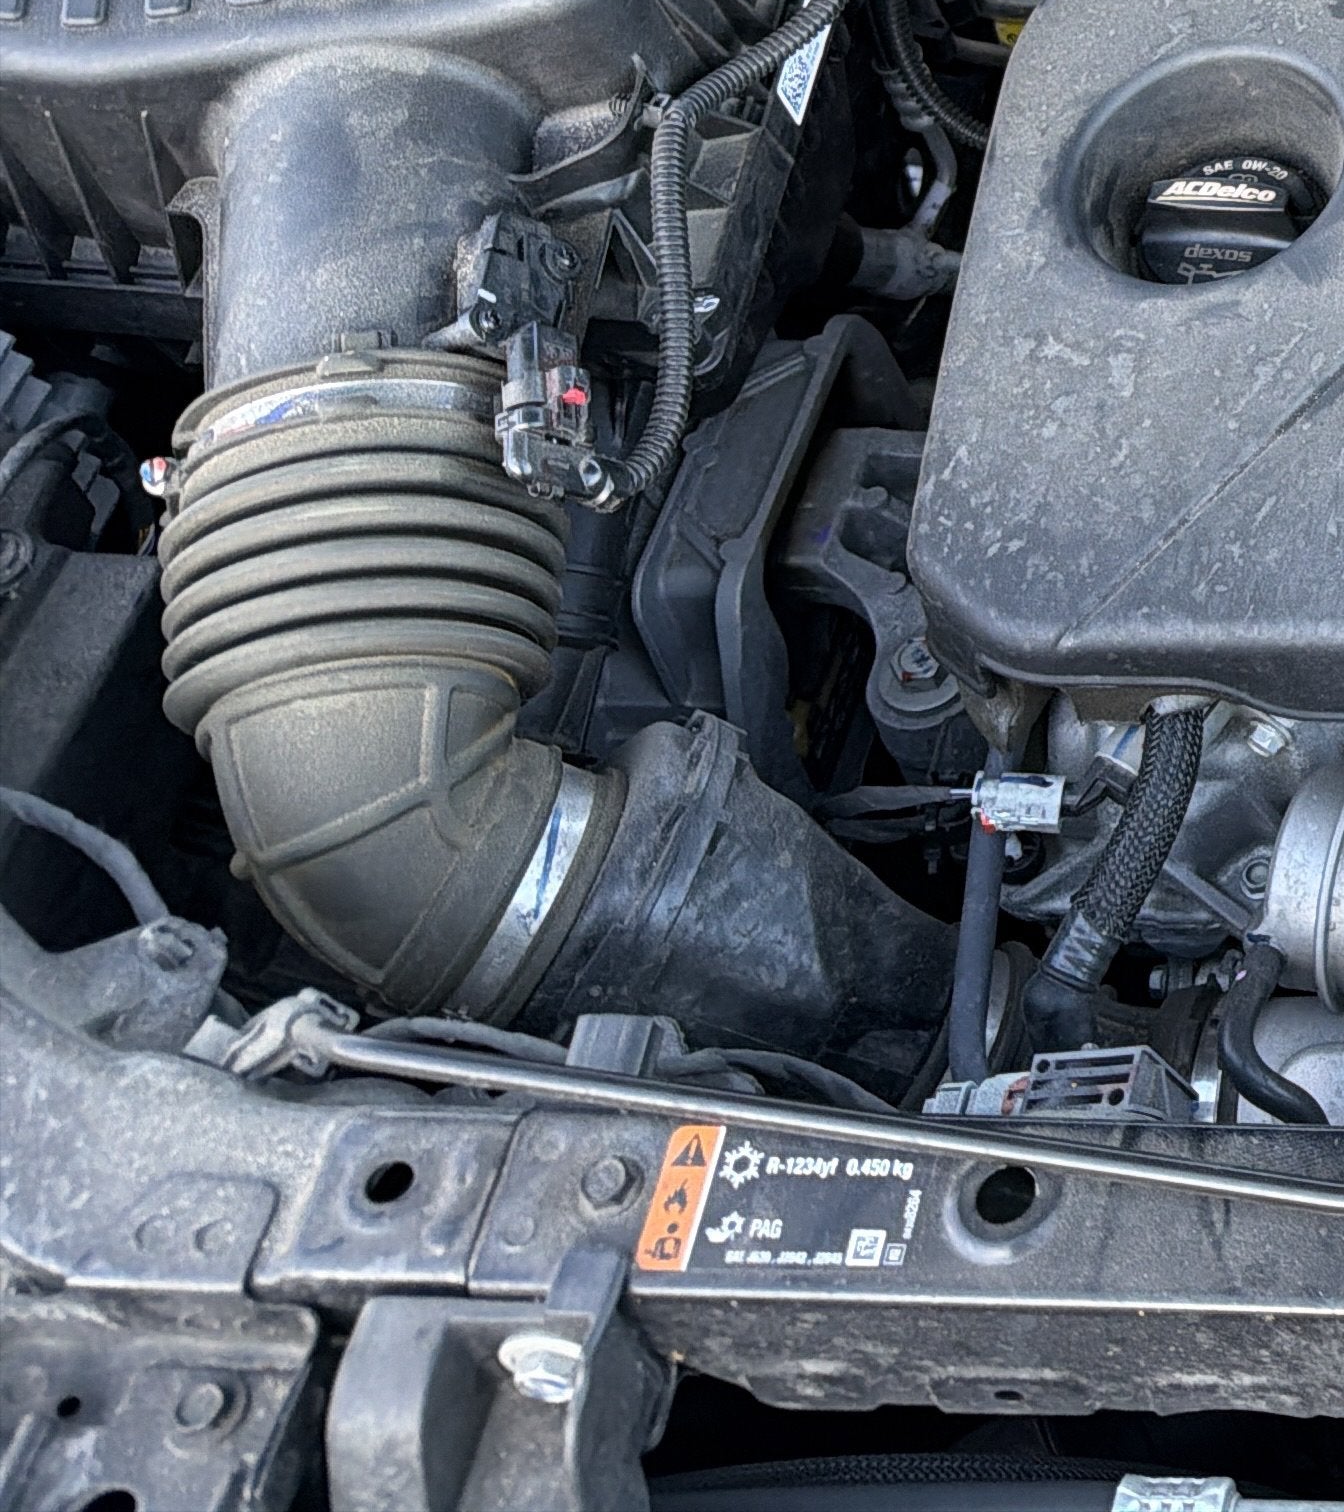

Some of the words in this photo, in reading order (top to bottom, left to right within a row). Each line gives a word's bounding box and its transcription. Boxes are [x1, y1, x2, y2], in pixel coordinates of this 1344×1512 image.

[1202, 159, 1234, 176] SAE
[1241, 159, 1289, 181] 0W-20
[1161, 180, 1278, 203] ACDelco
[1184, 243, 1254, 263] dexos
[765, 1156, 839, 1178] R-1234yf
[845, 1158, 891, 1177] 0.450
[892, 1159, 914, 1181] kg
[749, 1218, 784, 1240] PAG
